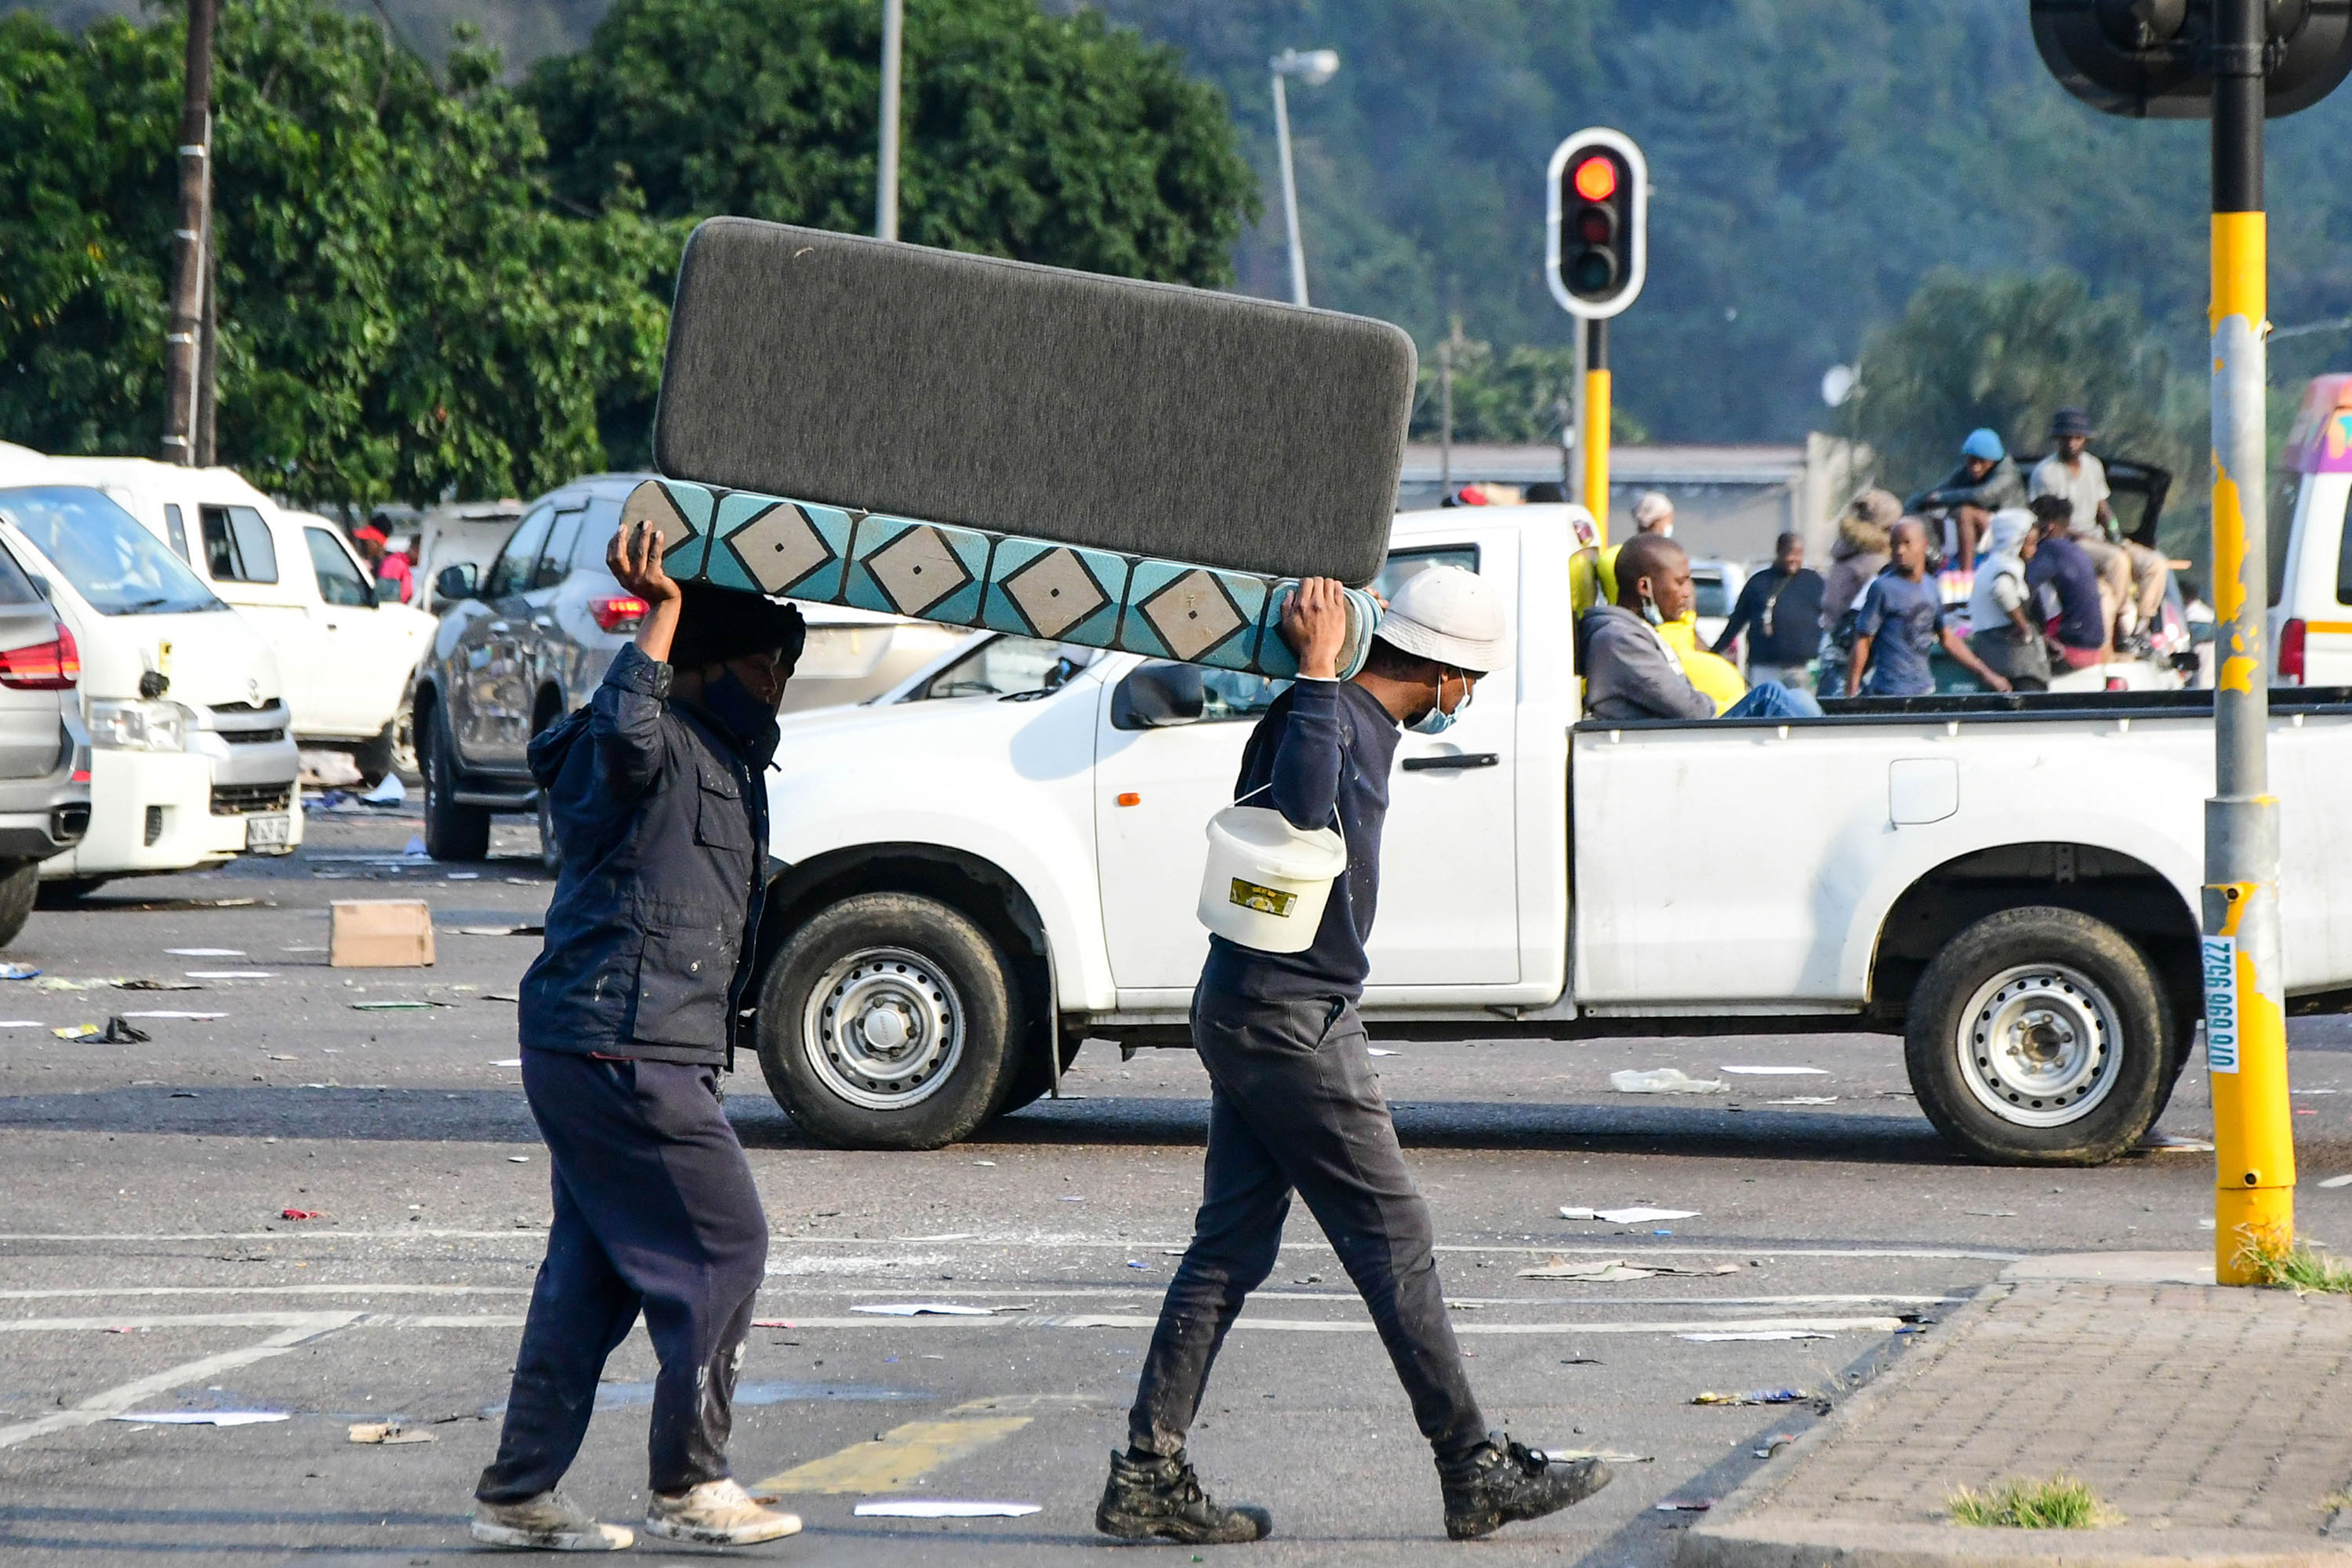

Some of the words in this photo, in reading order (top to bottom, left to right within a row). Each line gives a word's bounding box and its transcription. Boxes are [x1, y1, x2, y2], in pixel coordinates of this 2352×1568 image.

[2203, 942, 2232, 987] 9522
[2206, 993, 2233, 1029] 696
[2209, 1034, 2234, 1065] 076
